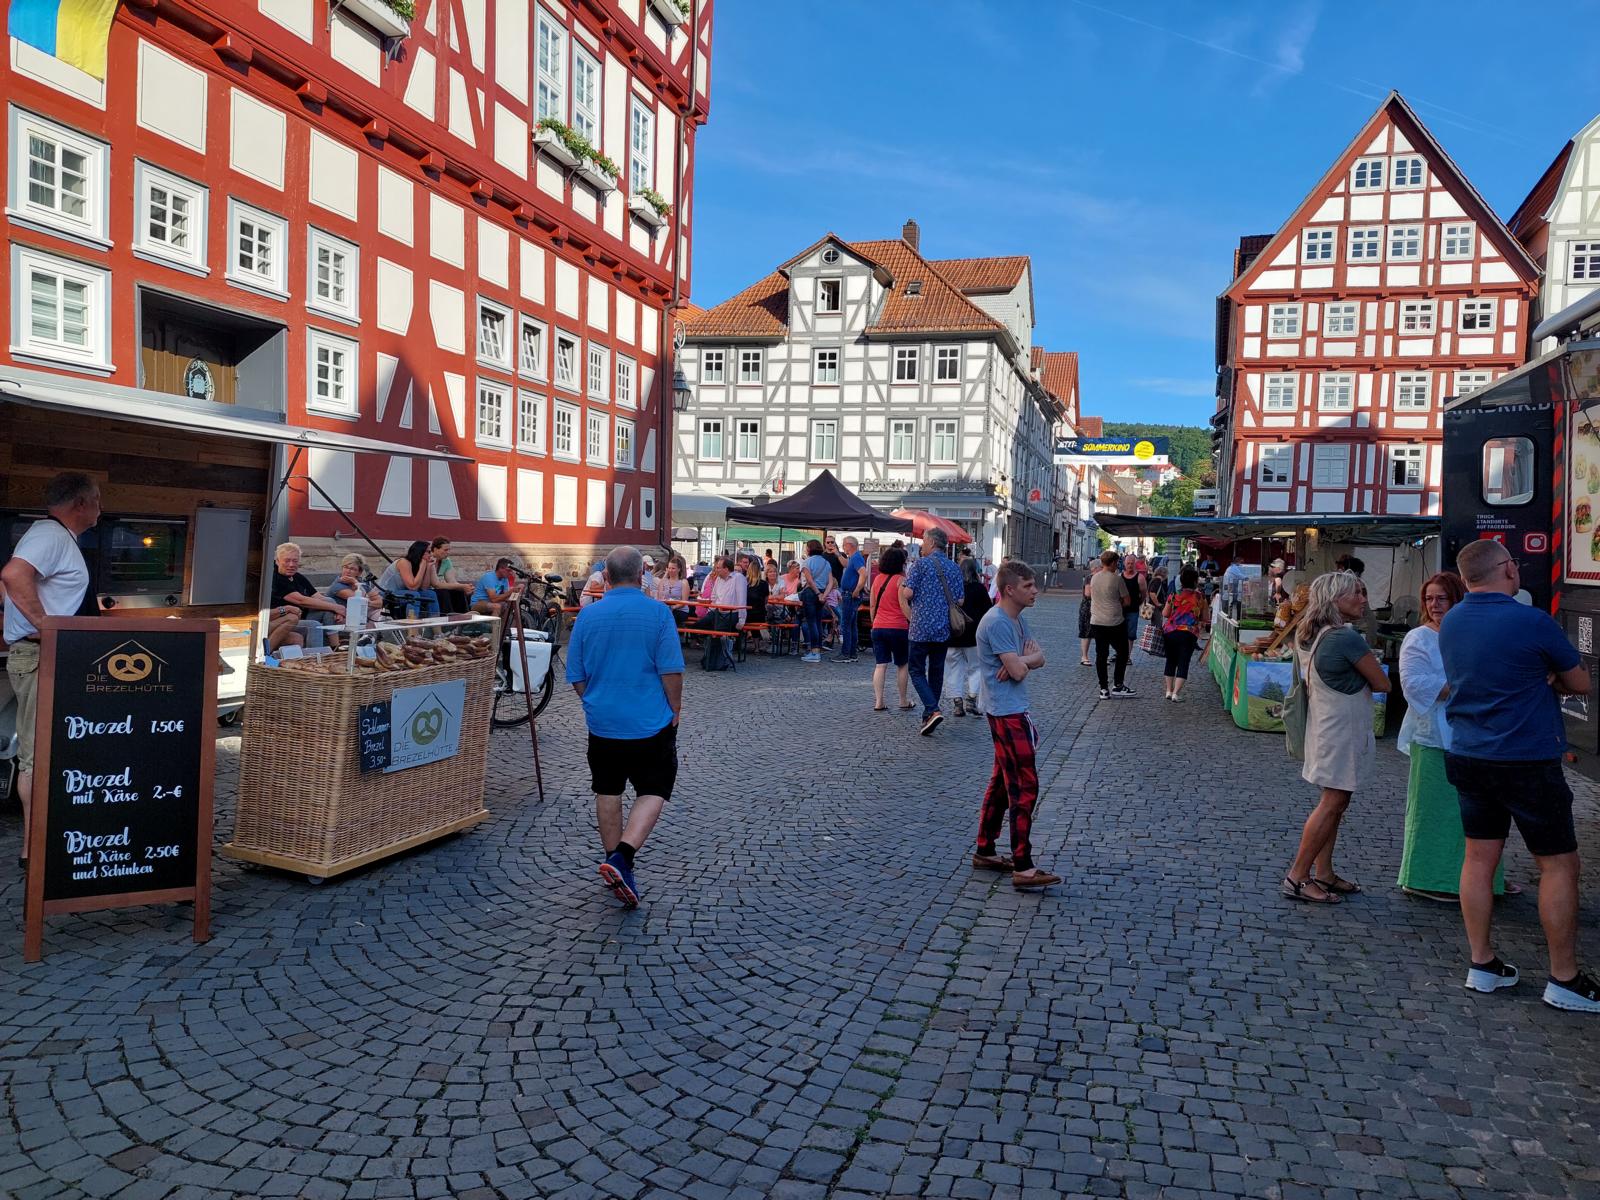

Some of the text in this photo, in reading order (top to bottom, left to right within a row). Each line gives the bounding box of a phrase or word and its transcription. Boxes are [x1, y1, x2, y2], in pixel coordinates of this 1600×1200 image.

[1082, 443, 1131, 452] SOMMERKINO
[86, 674, 108, 682] DIE
[85, 684, 174, 692] BREZELHÜTTE
[64, 715, 185, 740] Brezel 1.50€
[363, 737, 385, 755] Brezel
[392, 743, 454, 767] BREZELHÜTTE
[393, 741, 411, 753] DIE
[62, 766, 133, 793] Brezel
[72, 790, 95, 805] mit
[101, 788, 139, 803] Käse
[63, 826, 131, 854] Brezel
[73, 845, 180, 865] mit Käse 2.50€
[72, 862, 154, 880] und Schinken
